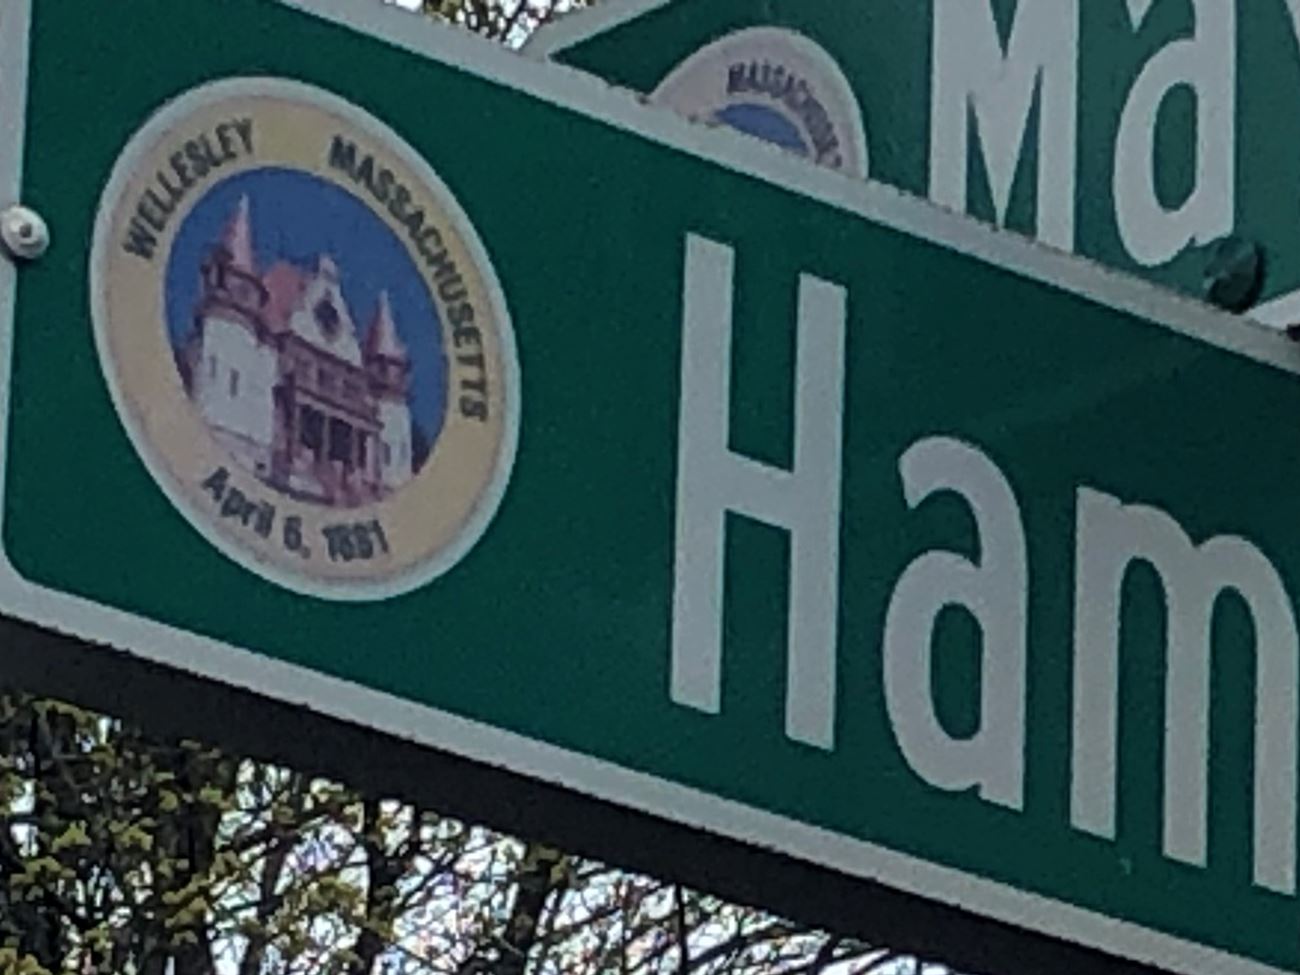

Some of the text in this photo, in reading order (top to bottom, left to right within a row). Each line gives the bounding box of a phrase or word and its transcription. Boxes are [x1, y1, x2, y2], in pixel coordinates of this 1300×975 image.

[122, 118, 489, 422] WELLESLEY MASSACHUSETTS
[202, 466, 275, 539] April
